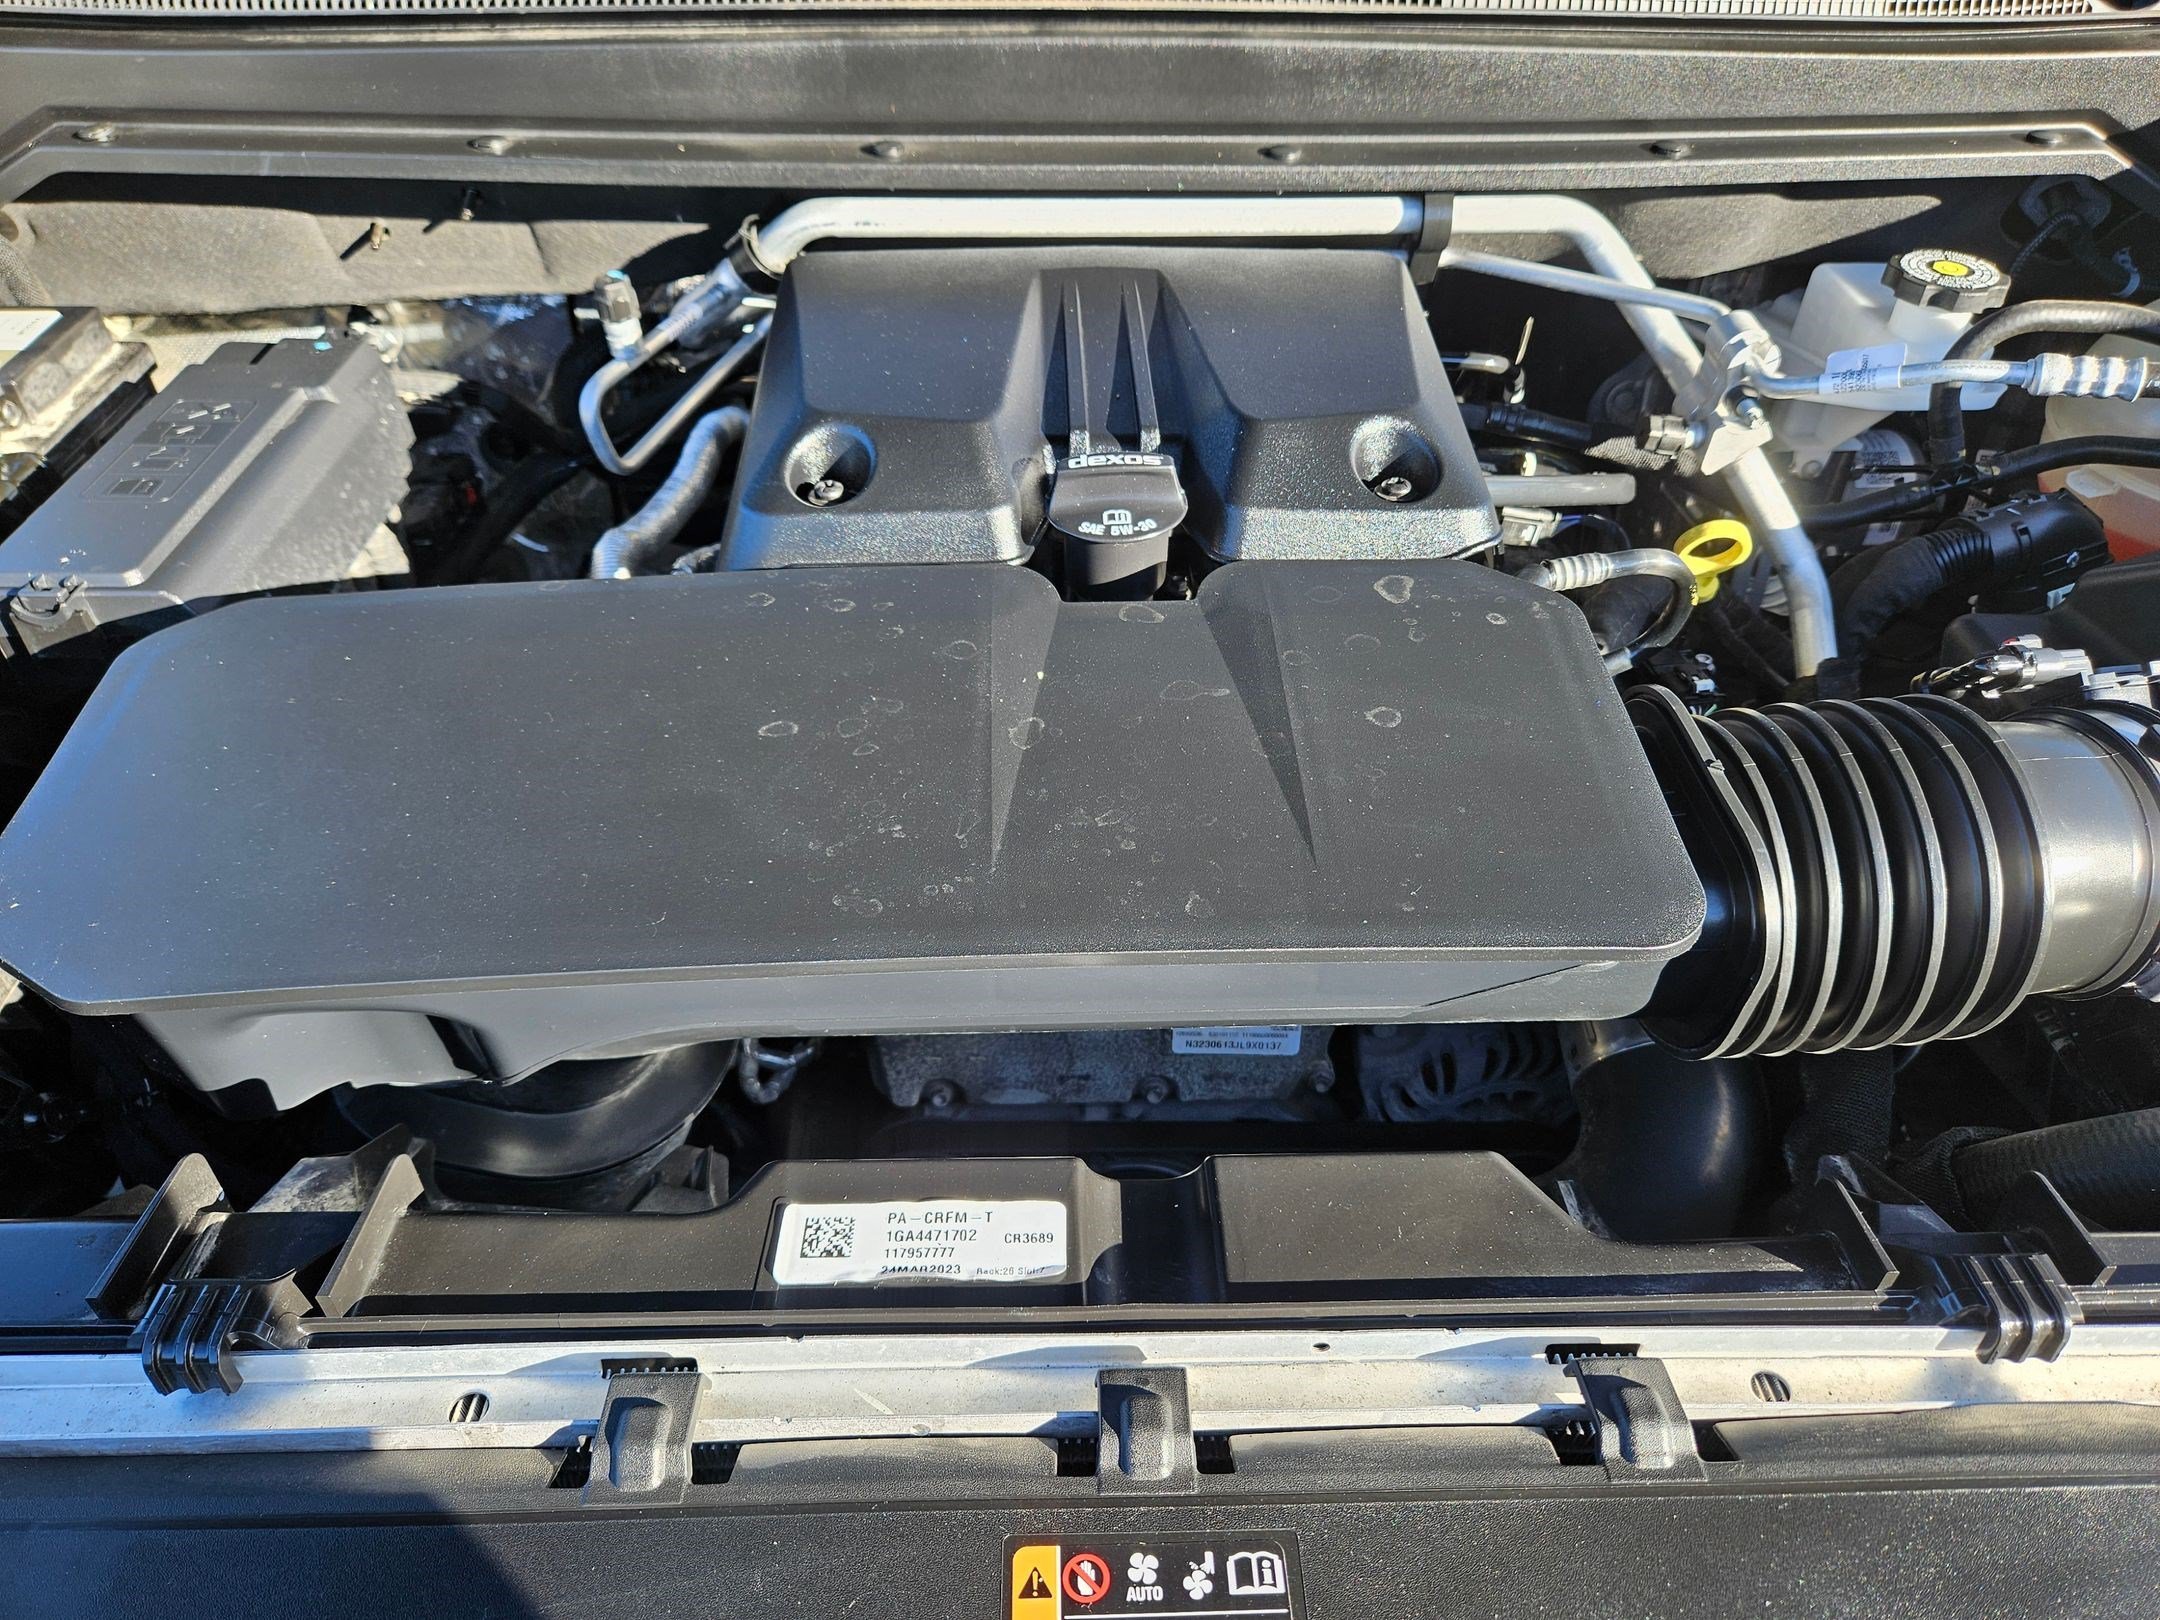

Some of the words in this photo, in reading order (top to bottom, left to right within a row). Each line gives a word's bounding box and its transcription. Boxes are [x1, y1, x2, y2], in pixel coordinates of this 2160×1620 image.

[1068, 454, 1164, 469] dexos
[1078, 521, 1106, 536] SAE
[1110, 518, 1158, 536] 5W-30
[887, 1229, 977, 1243] 1GA4471702
[1004, 1232, 1054, 1244] CR3689
[884, 1246, 955, 1259] 117957777
[881, 1264, 961, 1275] 24MAR2023
[1126, 1585, 1164, 1602] AUTO
